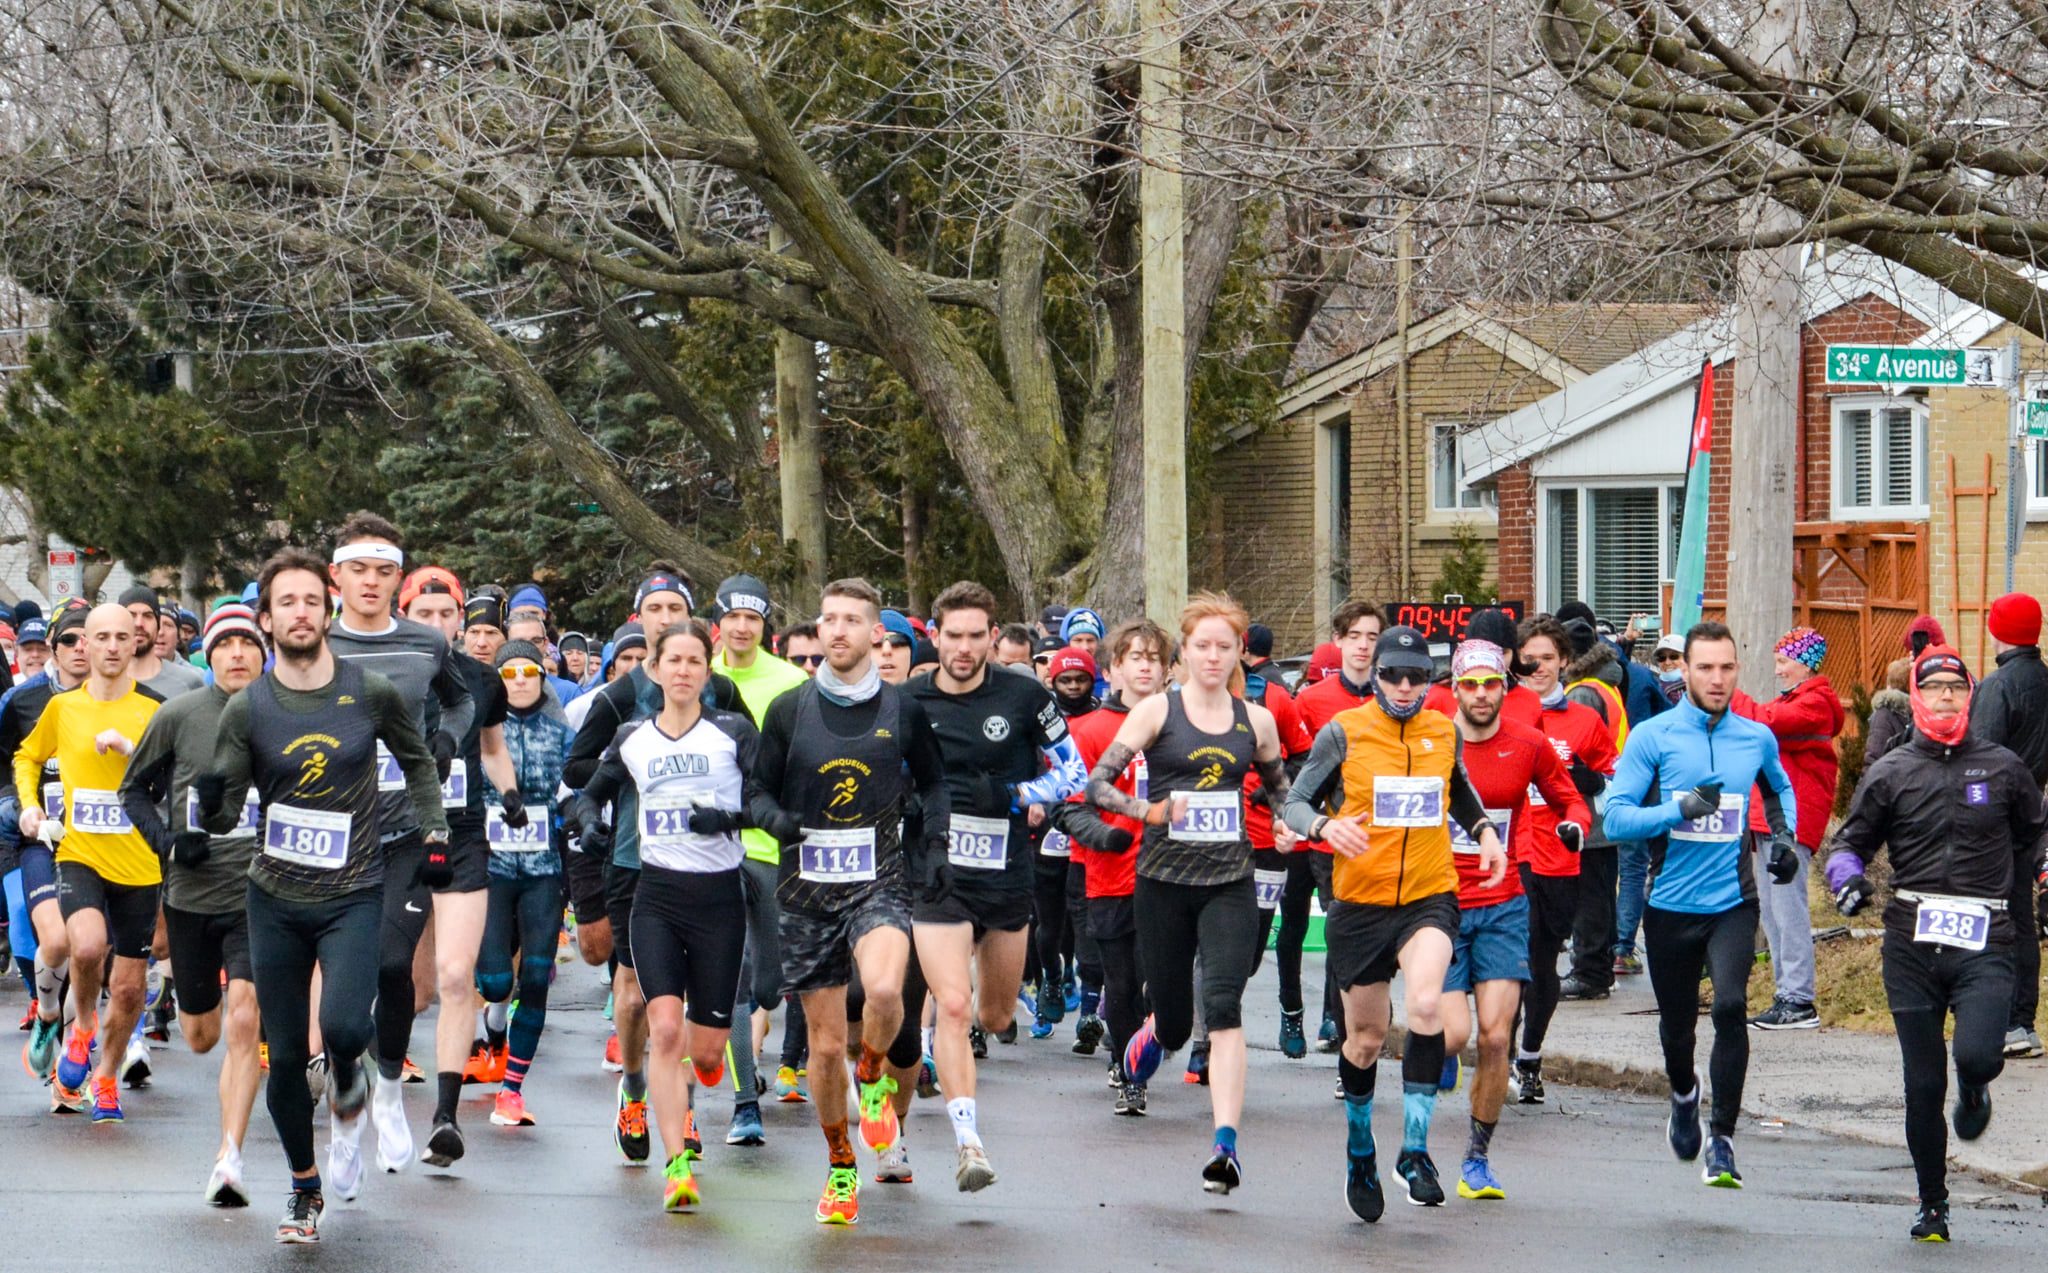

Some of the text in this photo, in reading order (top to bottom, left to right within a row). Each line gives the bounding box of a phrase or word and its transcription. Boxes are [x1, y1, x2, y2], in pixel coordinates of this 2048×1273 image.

[1876, 352, 1958, 378] Avenue
[648, 753, 709, 779] CAVD
[818, 758, 872, 777] VAINQUEURS
[82, 804, 121, 826] 218
[1395, 794, 1424, 818] 72
[500, 822, 538, 842] 192
[654, 809, 697, 835] 21
[1184, 808, 1228, 832] 130
[1692, 810, 1723, 833] 96
[281, 826, 332, 856] 180
[814, 847, 861, 873] 114
[1928, 910, 1975, 939] 238
